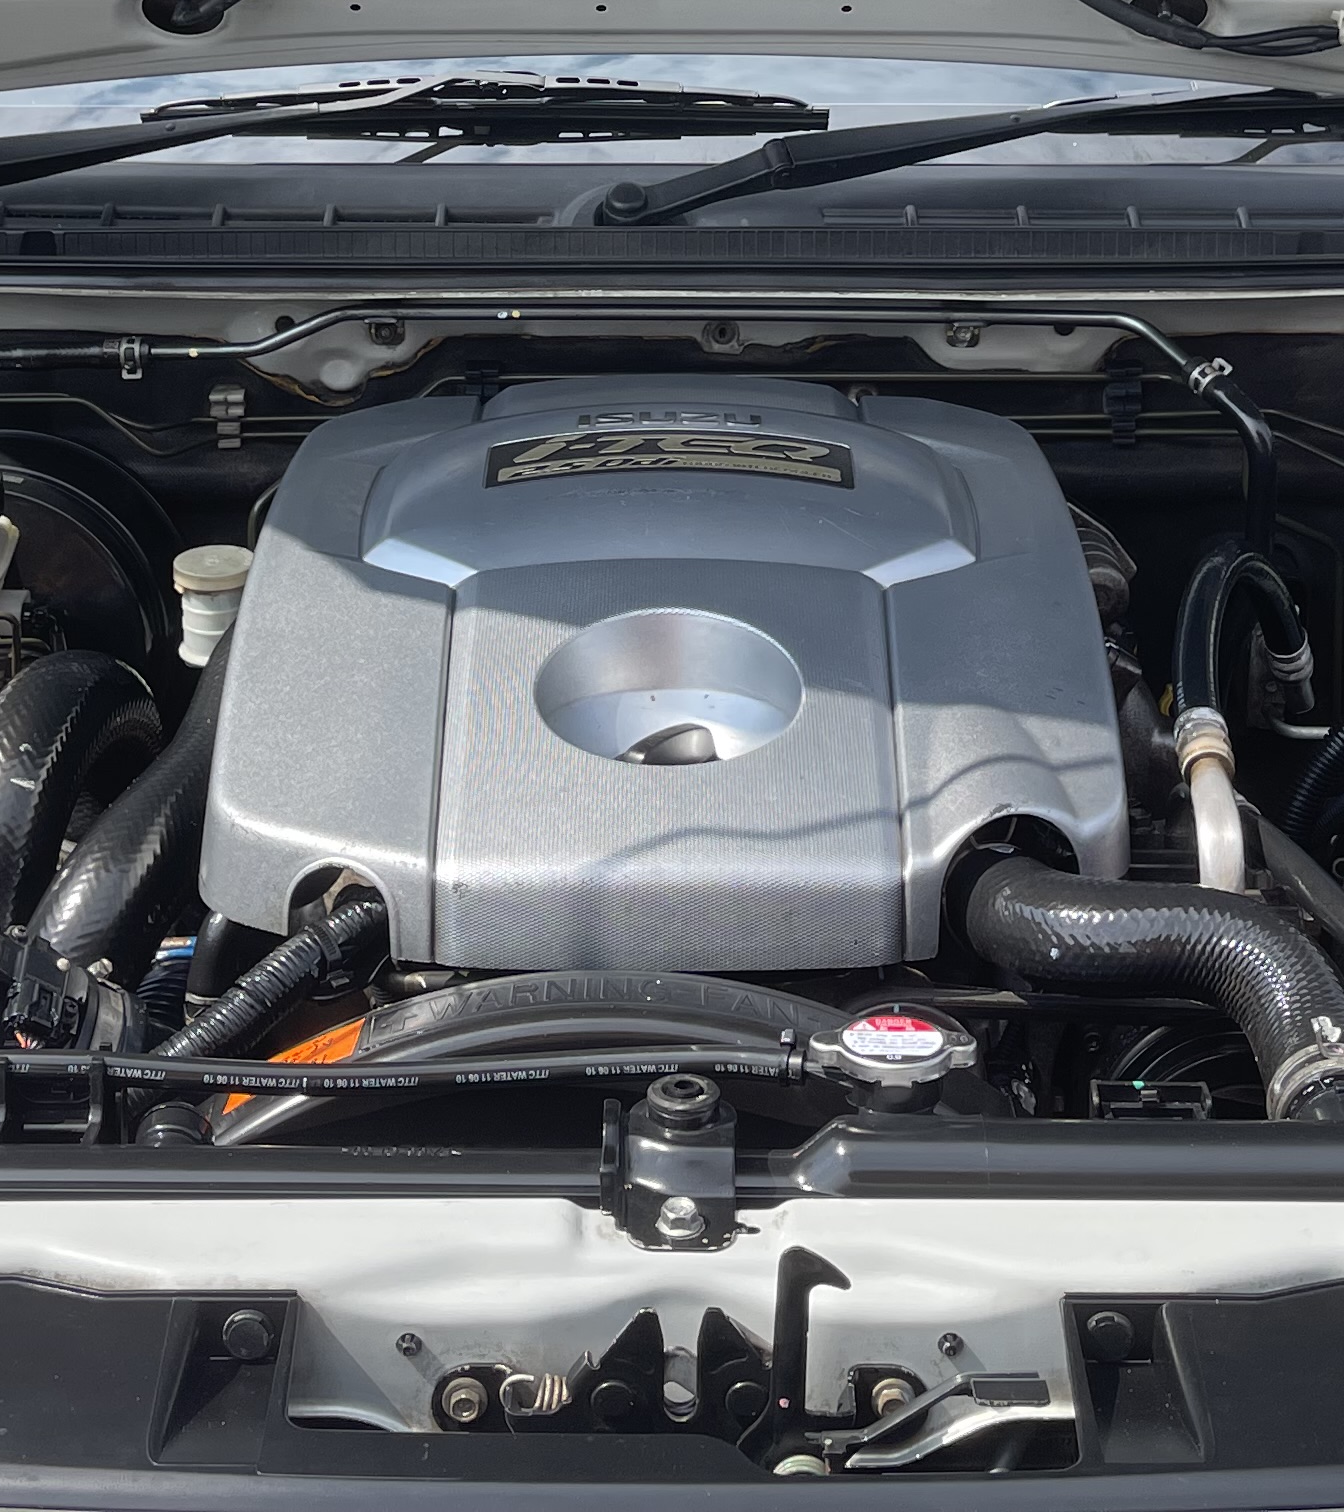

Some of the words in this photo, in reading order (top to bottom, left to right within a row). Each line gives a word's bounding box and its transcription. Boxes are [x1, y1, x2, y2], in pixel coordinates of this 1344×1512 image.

[577, 411, 762, 429] ISUZU
[427, 977, 666, 1021] WARNING
[700, 983, 801, 1027] FAN
[107, 1066, 142, 1079] WATER
[623, 1064, 657, 1074] WATER
[493, 1070, 527, 1081] WATER
[242, 1076, 277, 1088] WATER
[362, 1077, 397, 1088] WATER
